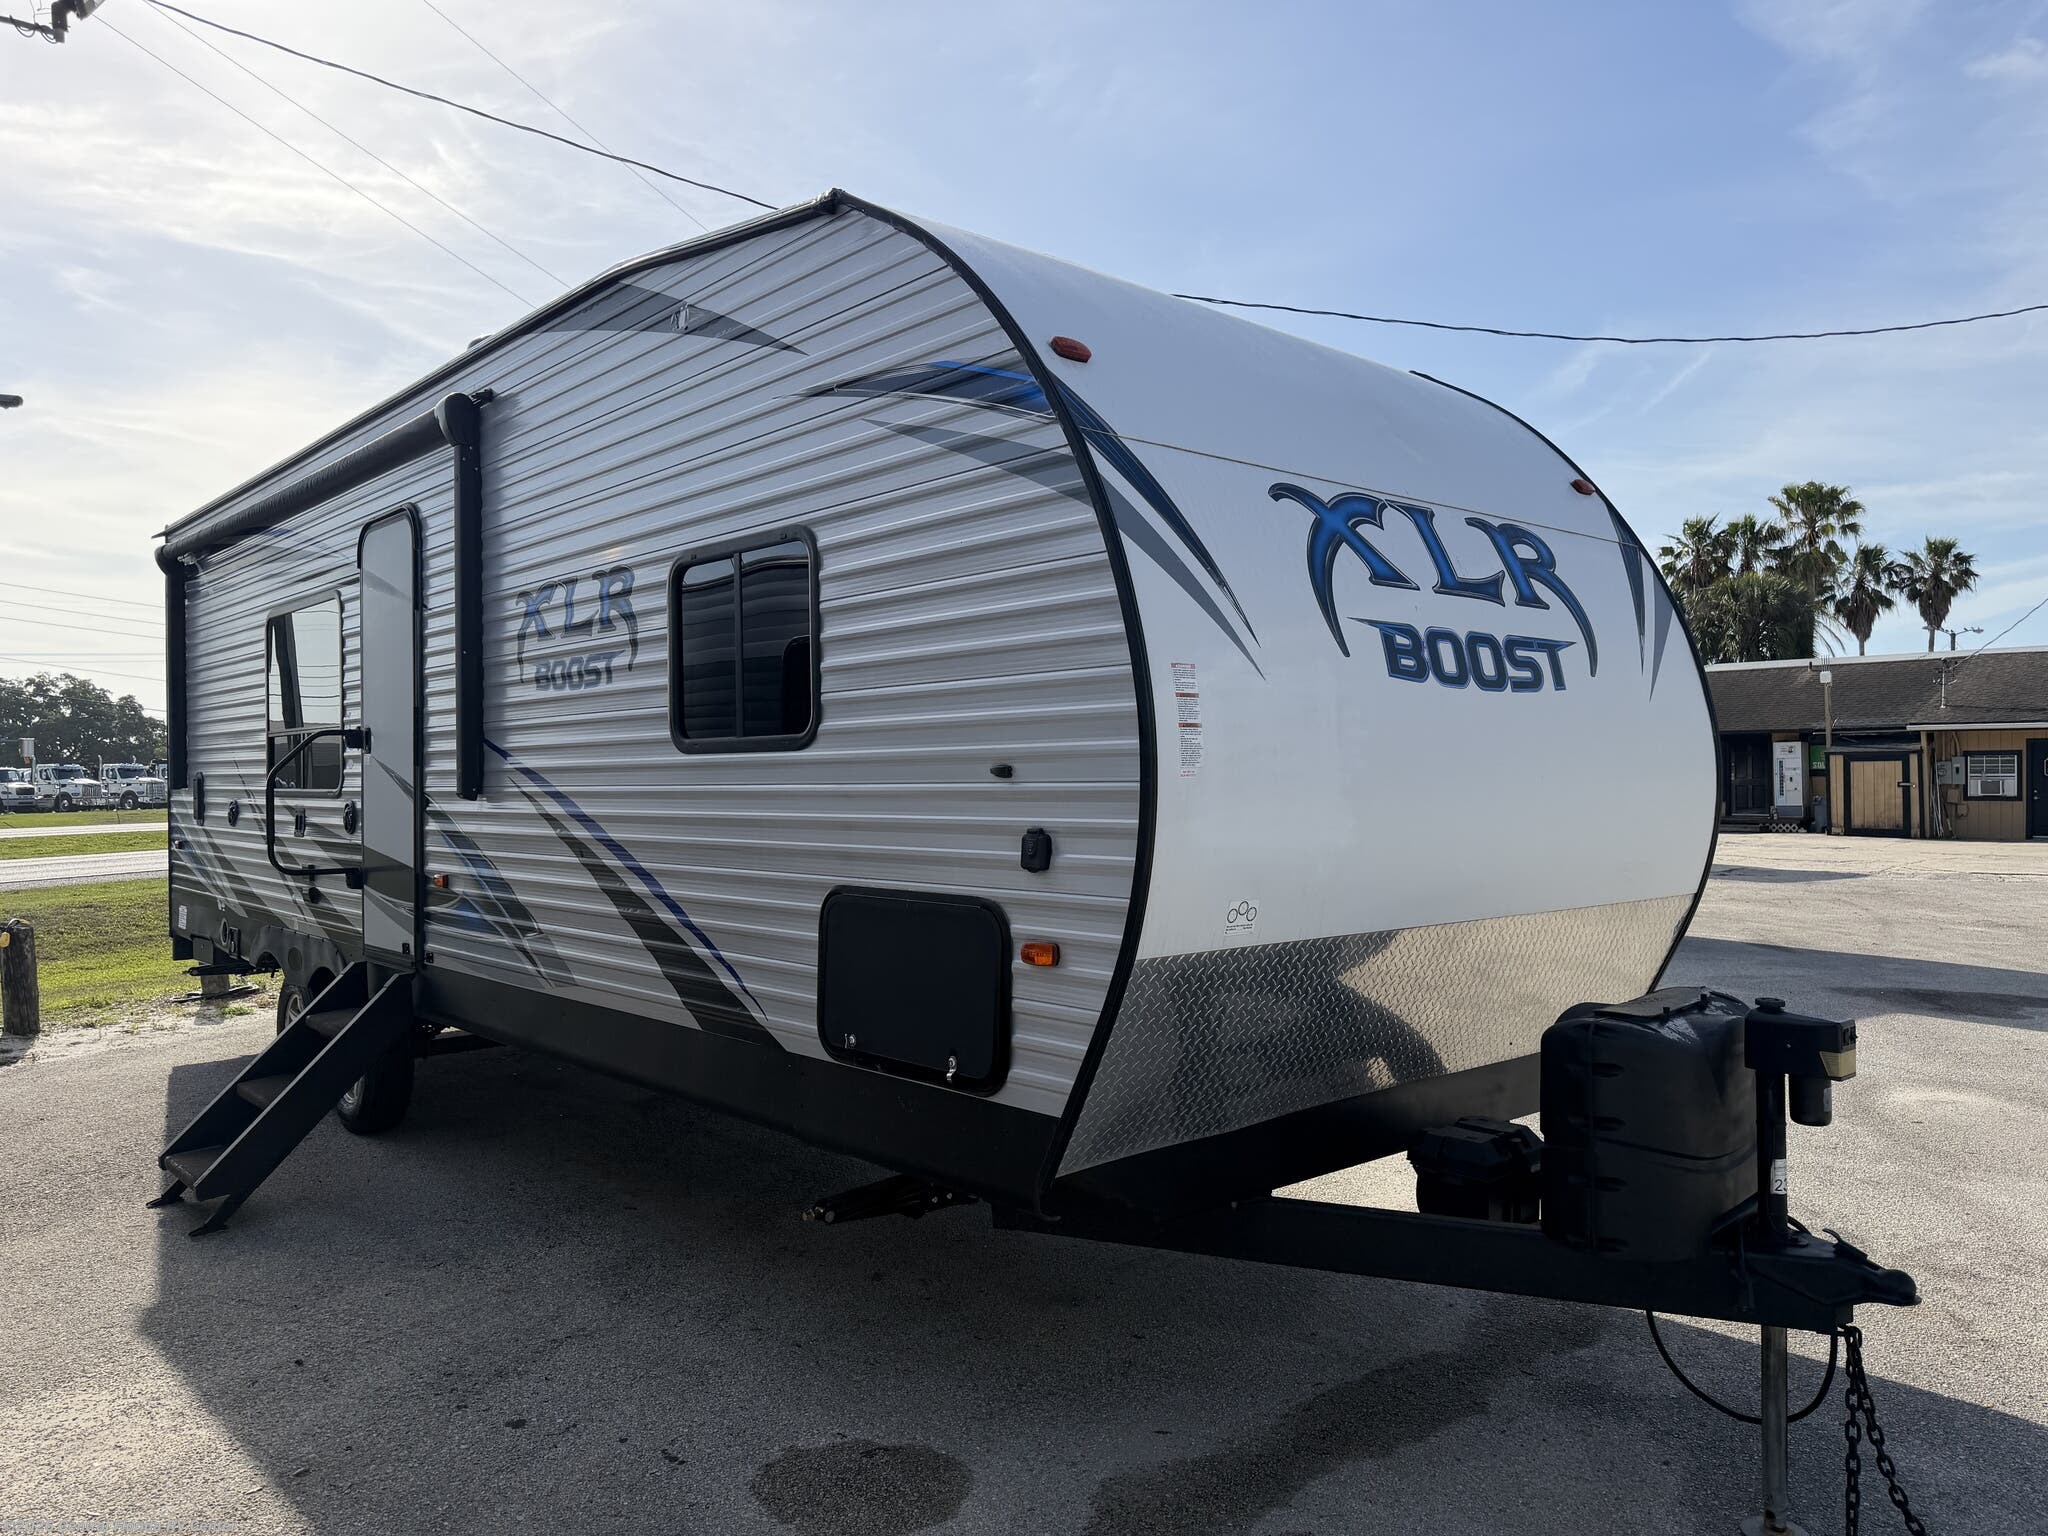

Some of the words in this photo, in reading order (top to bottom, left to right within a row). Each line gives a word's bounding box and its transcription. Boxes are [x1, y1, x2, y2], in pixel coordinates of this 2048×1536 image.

[516, 565, 639, 683] XLR
[1267, 482, 1599, 678] XLR
[535, 649, 626, 692] BOOST
[1347, 617, 1577, 693] BOOST
